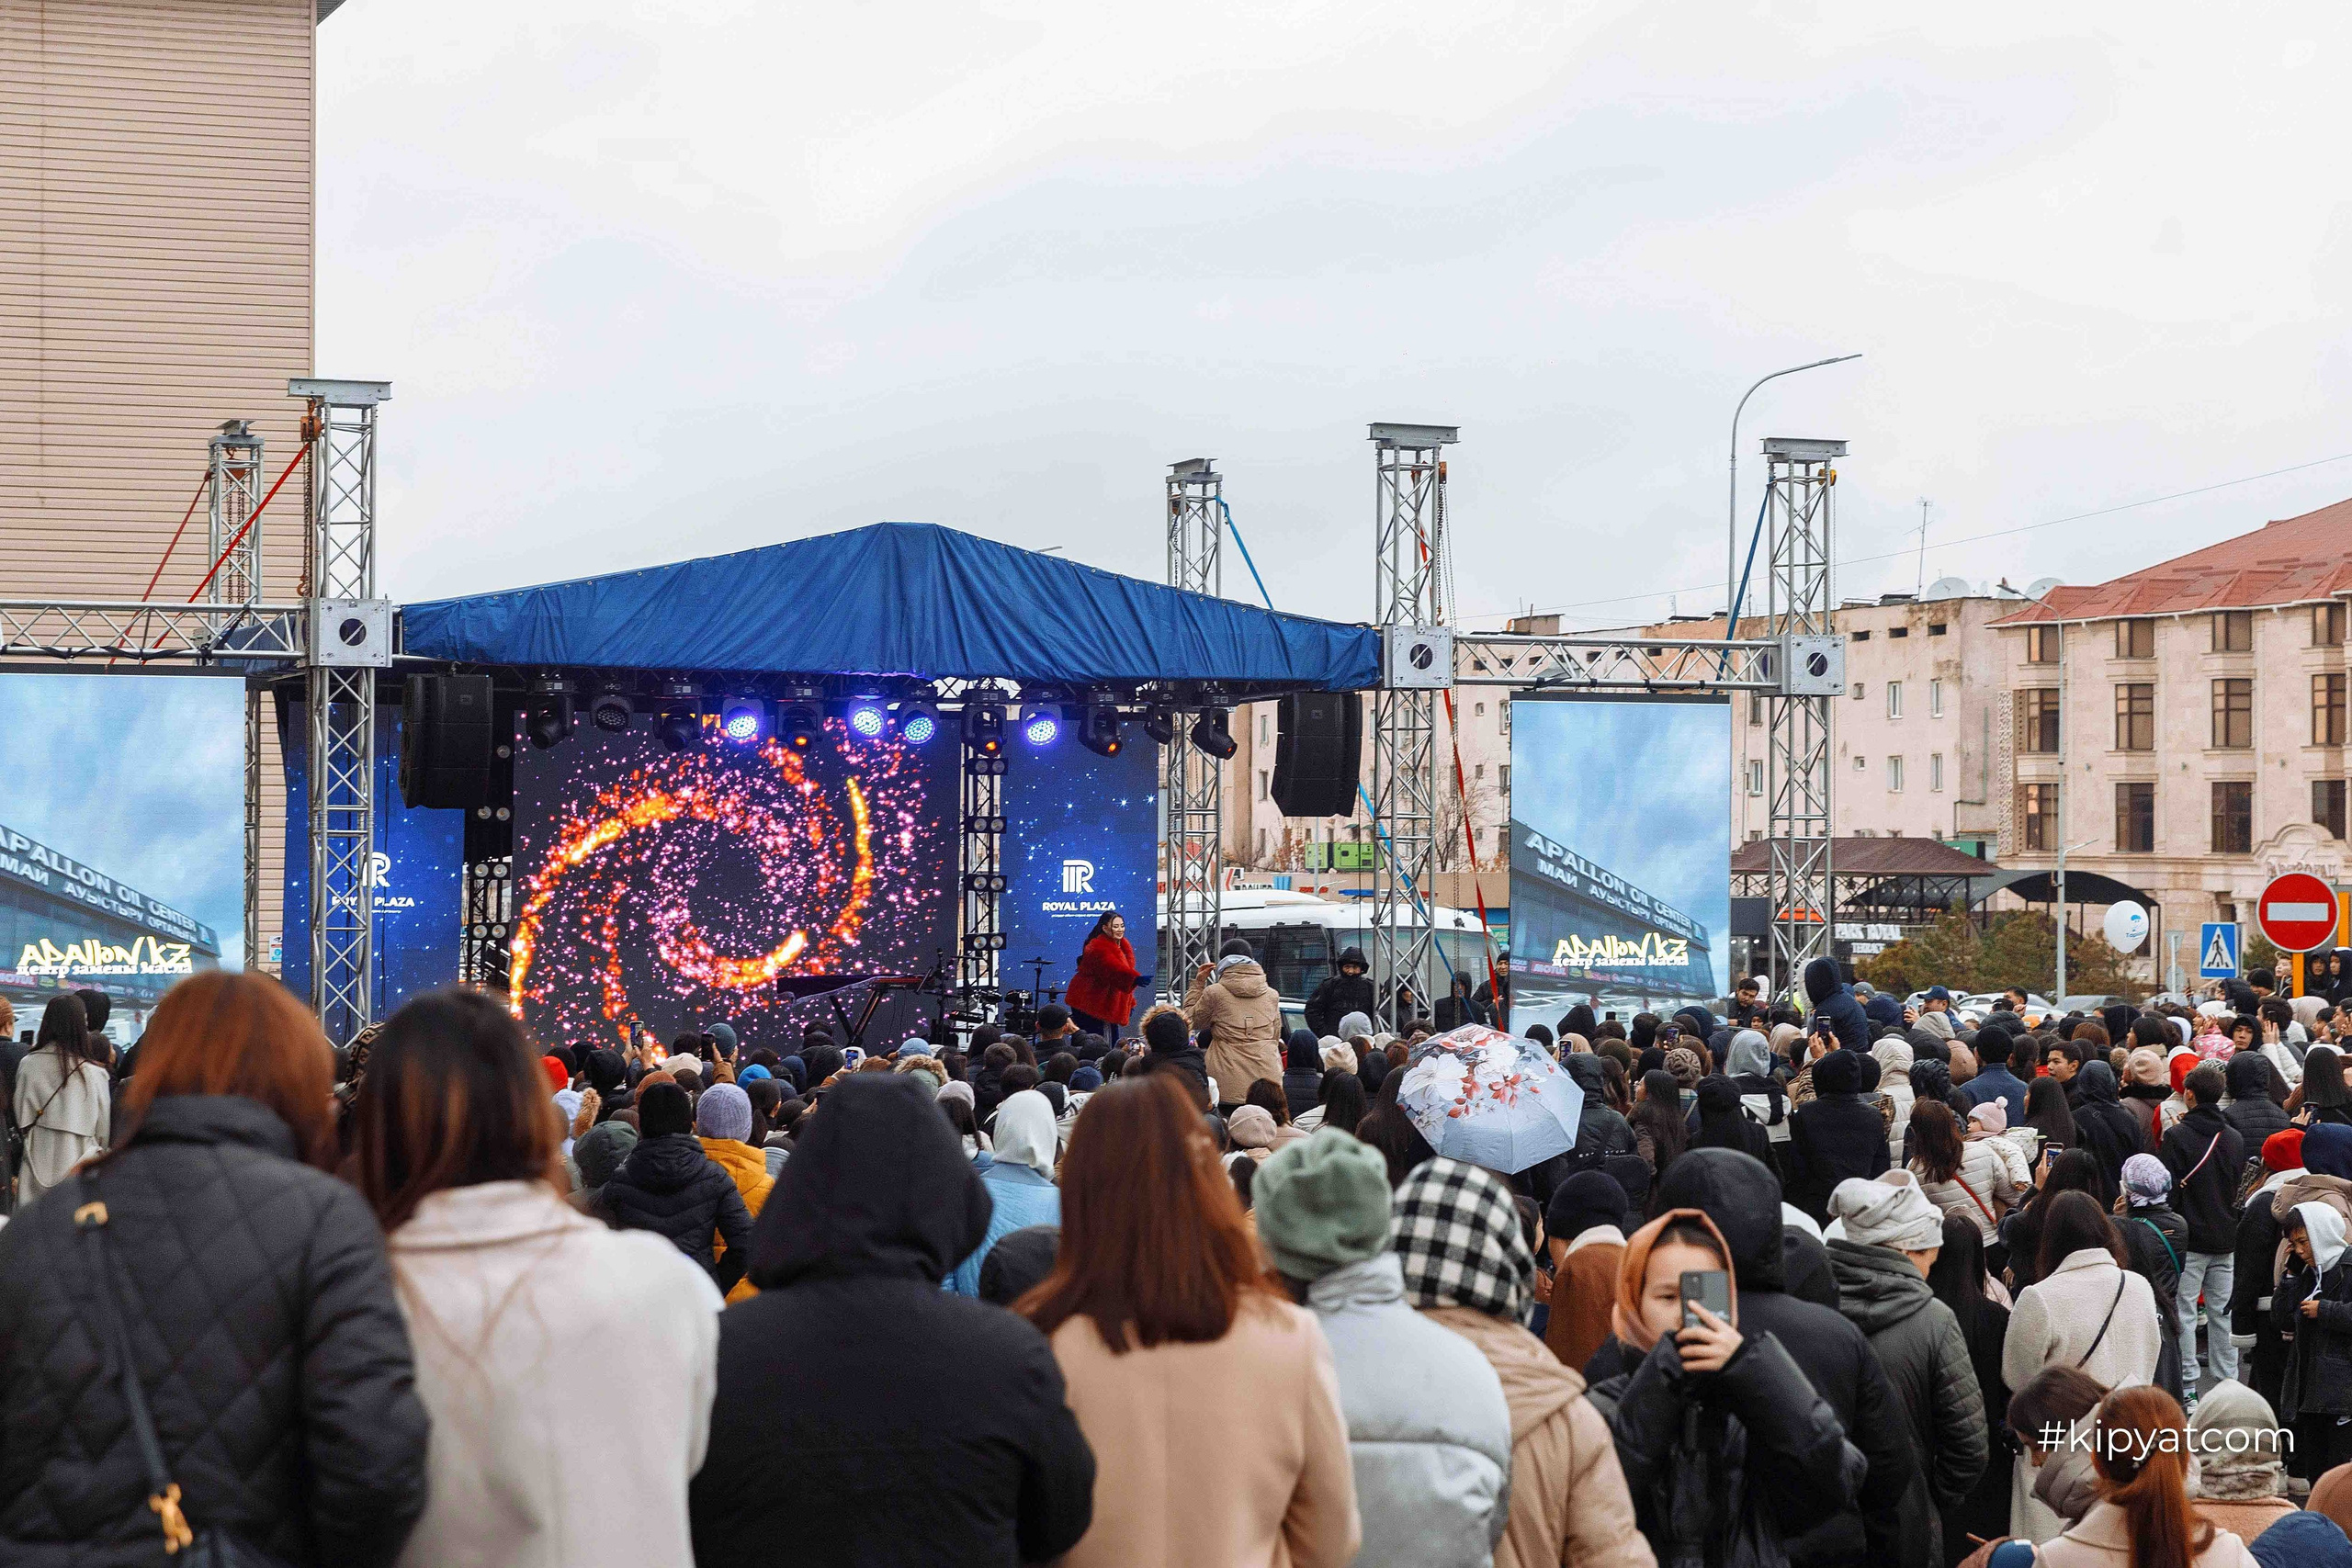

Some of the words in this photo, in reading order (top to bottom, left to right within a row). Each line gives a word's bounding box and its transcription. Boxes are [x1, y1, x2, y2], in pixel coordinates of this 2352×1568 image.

[1525, 832, 1625, 896] APALLON
[1630, 887, 1651, 908] OIL
[117, 886, 145, 909] OIL
[374, 897, 415, 907] PLAZA
[1043, 901, 1079, 911] ROYAL
[1080, 901, 1116, 911] PLAZA
[1552, 958, 1593, 969] центр
[1595, 958, 1645, 966] замены
[1647, 957, 1690, 966] масла
[16, 964, 70, 978] центр
[72, 964, 138, 975] замены
[140, 964, 193, 975] масла
